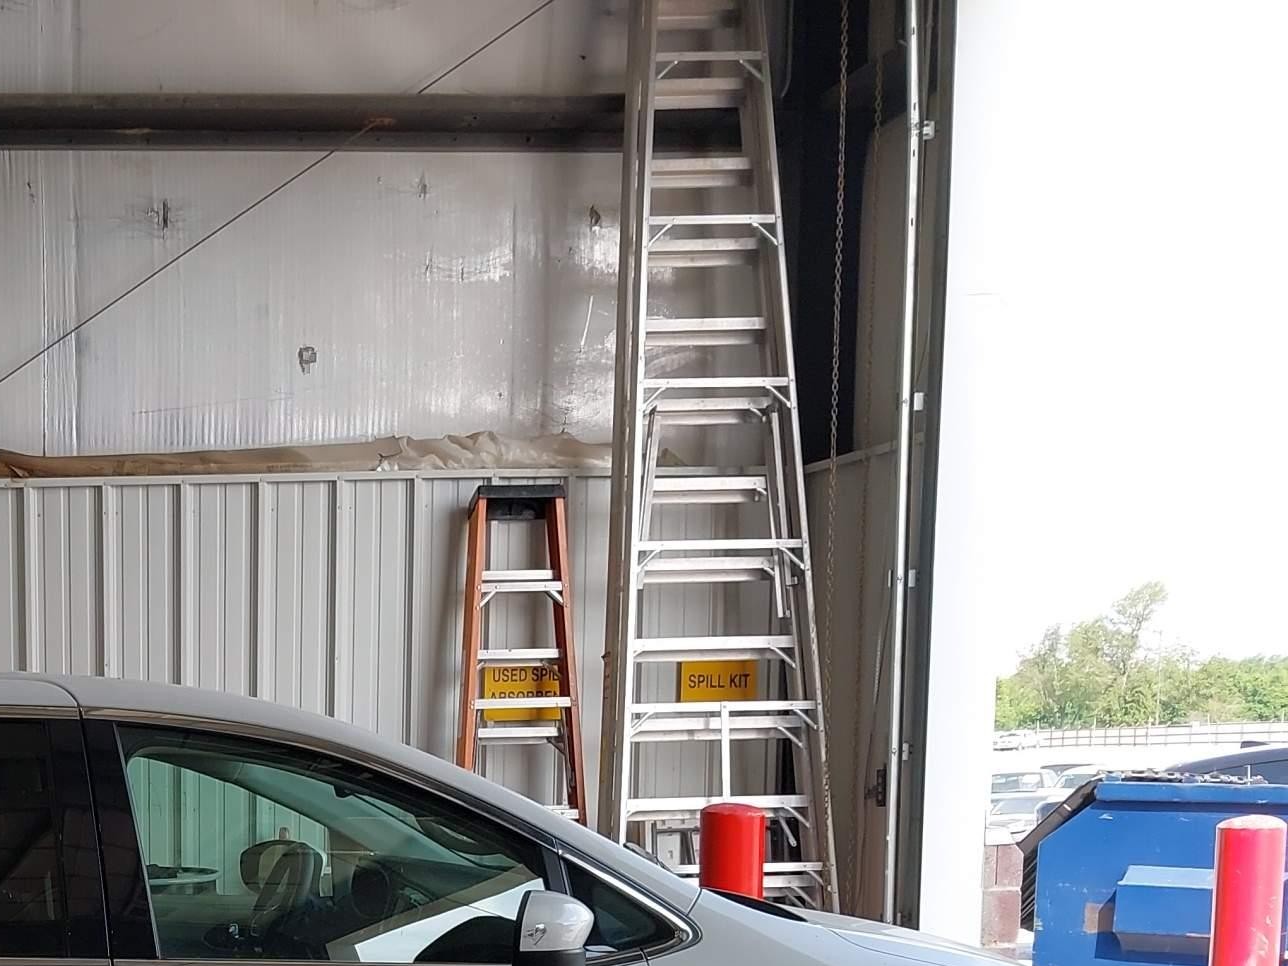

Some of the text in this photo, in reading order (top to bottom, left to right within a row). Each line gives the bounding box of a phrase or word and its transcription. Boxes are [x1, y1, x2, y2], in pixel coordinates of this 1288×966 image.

[493, 667, 560, 683] USED SPIL
[688, 673, 751, 689] SPILL KIT
